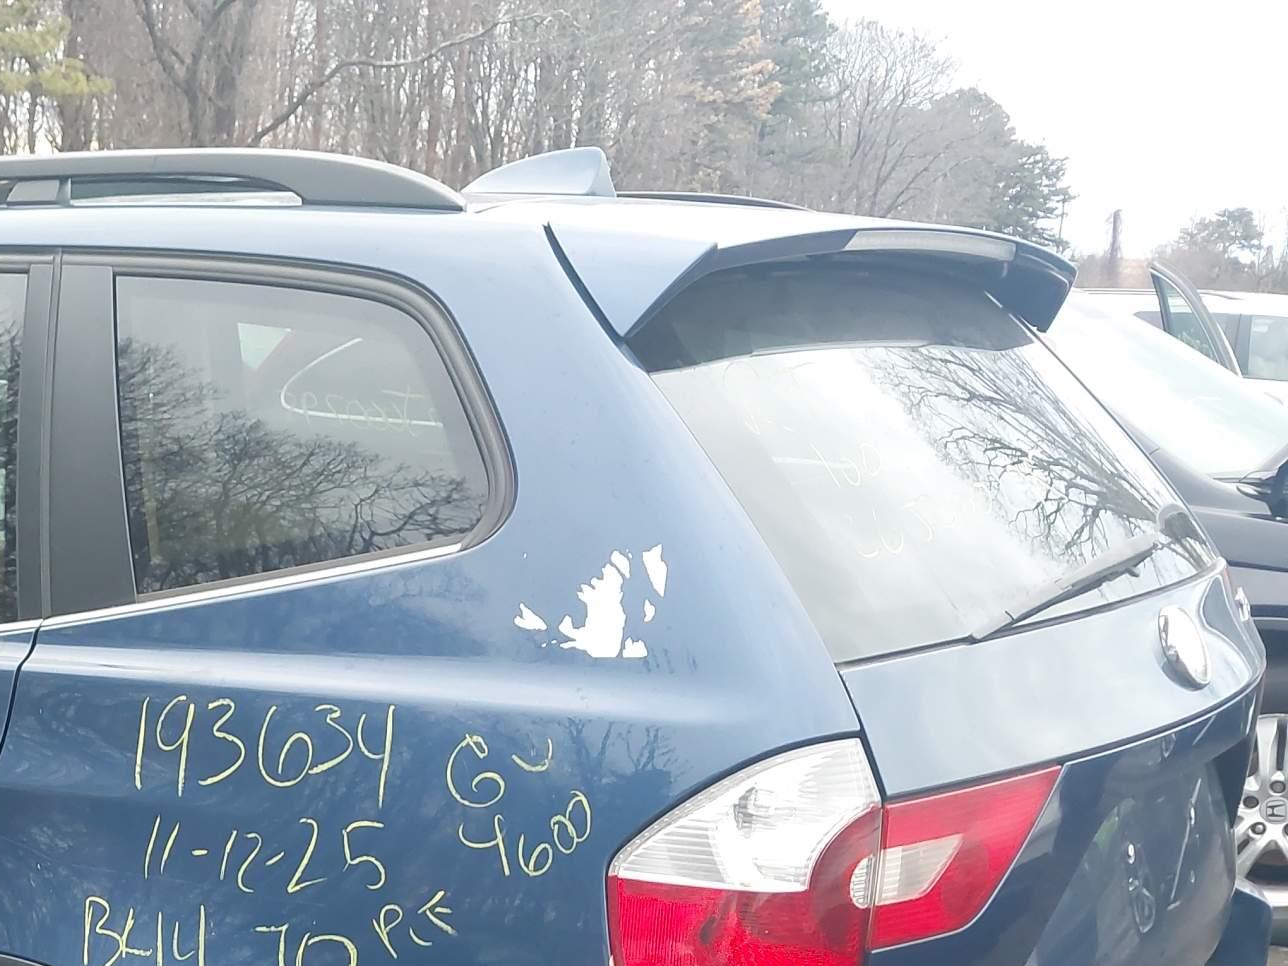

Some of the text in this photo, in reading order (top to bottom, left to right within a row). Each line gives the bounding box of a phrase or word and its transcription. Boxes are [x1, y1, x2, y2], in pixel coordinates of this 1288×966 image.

[135, 695, 396, 808] 193634
[144, 814, 386, 894] 11-12-25
[458, 790, 591, 877] 4600
